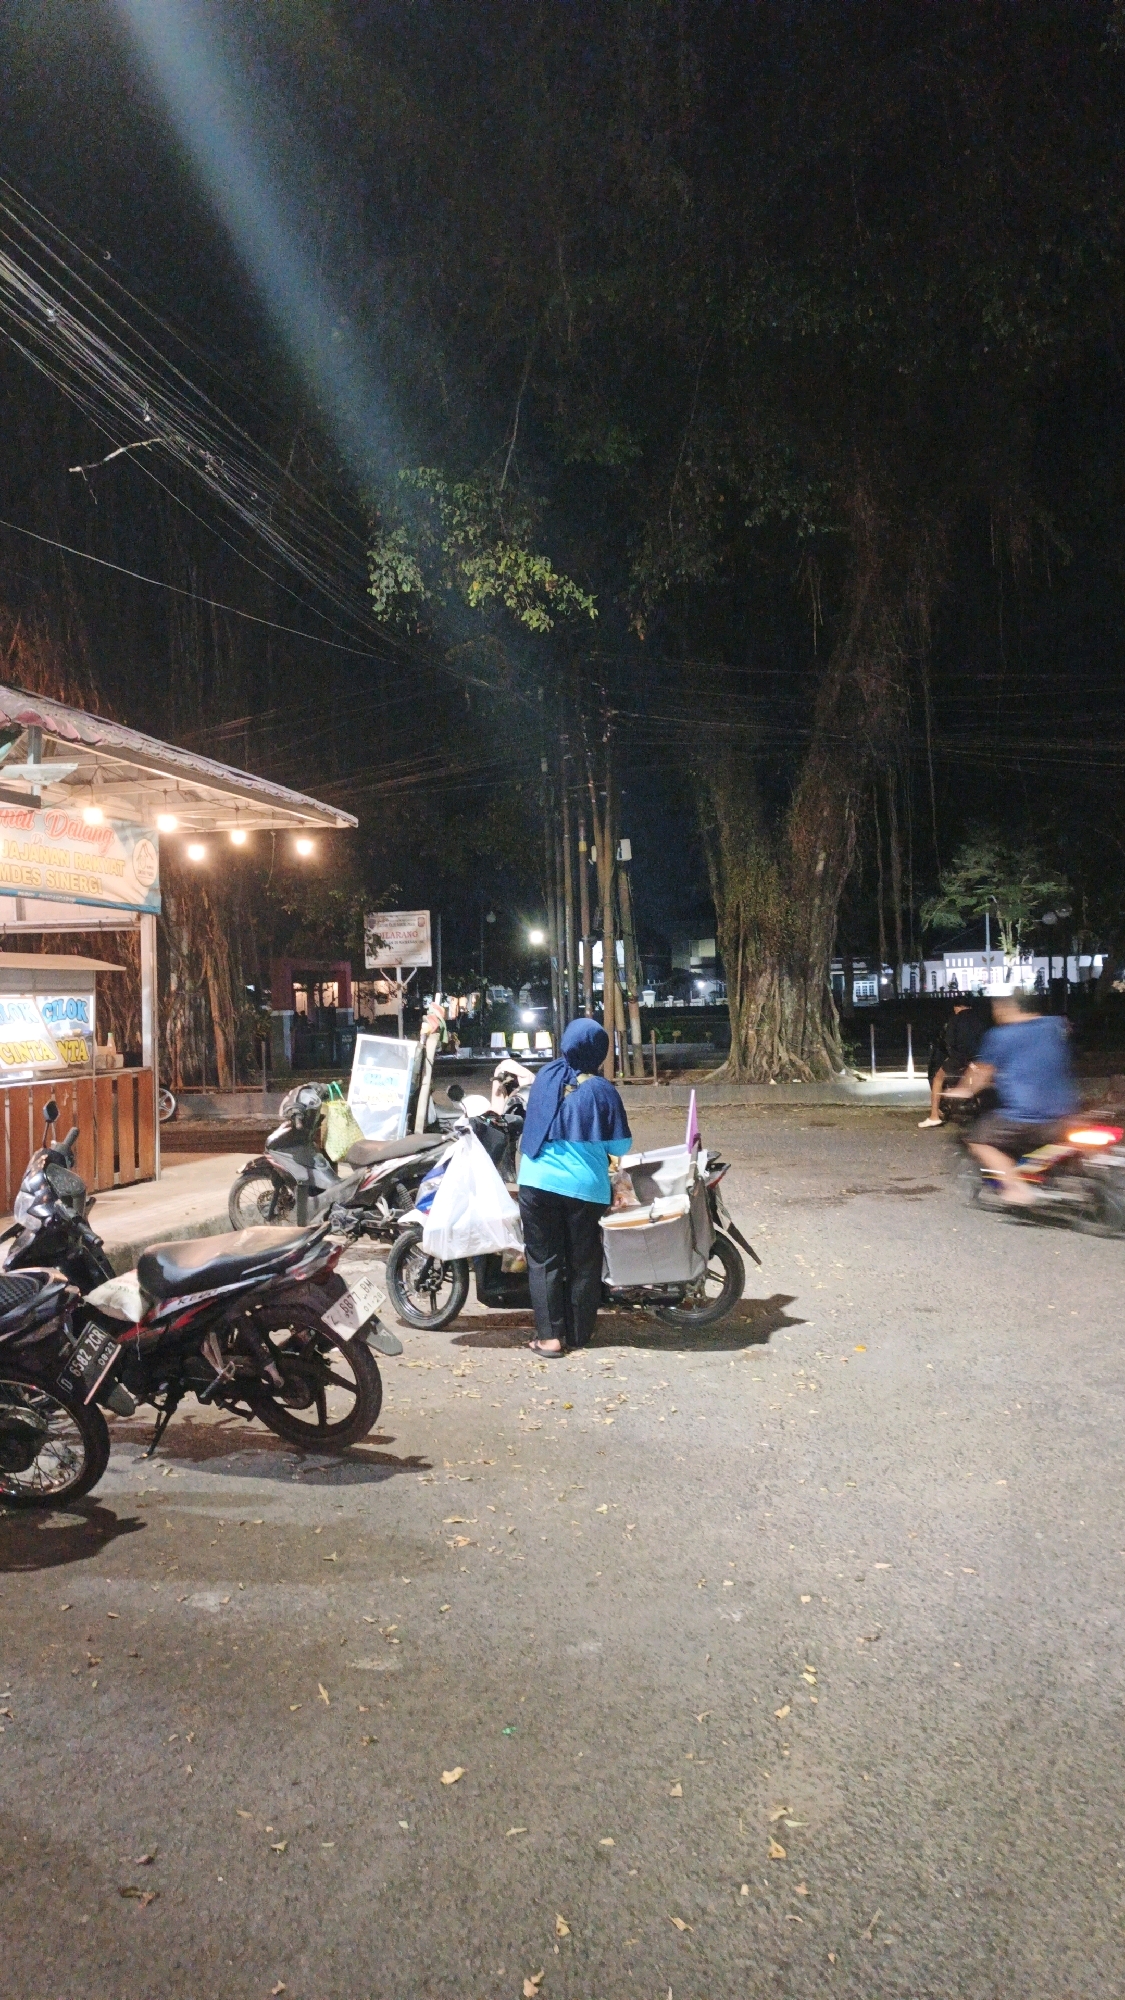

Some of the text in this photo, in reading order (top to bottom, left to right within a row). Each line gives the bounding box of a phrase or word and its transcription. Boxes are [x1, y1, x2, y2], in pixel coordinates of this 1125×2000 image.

[44, 808, 116, 855] Datang
[2, 839, 126, 878] JAJANAN RAKYAT
[45, 870, 104, 894] SINERGI
[41, 997, 89, 1024] CILOK
[0, 1039, 57, 1065] CINTA
[56, 1038, 90, 1062] NTA
[339, 1290, 362, 1315] 6877
[359, 1280, 376, 1294] BM
[60, 1328, 108, 1391] D 6582 ZCR
